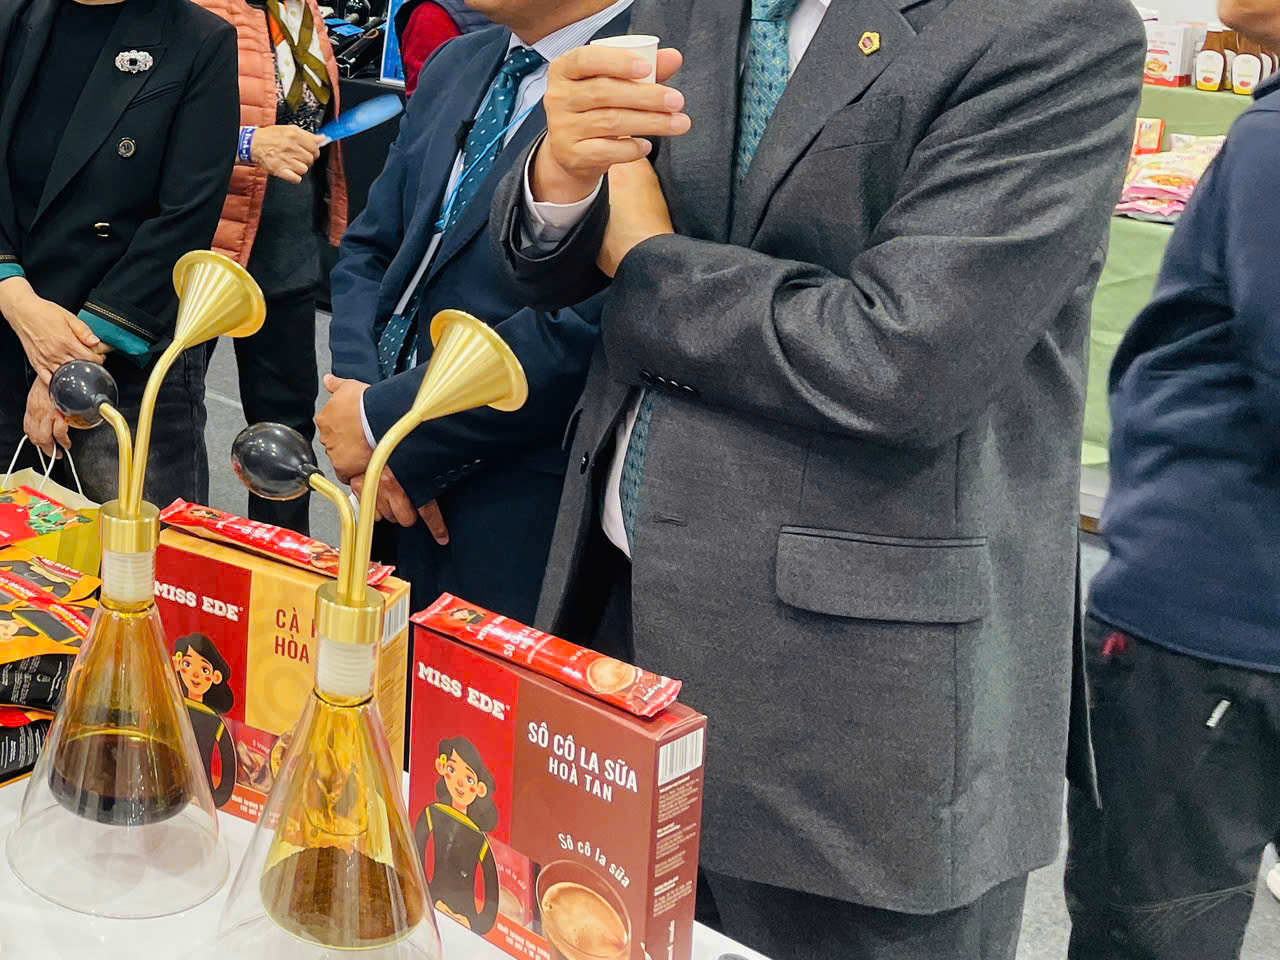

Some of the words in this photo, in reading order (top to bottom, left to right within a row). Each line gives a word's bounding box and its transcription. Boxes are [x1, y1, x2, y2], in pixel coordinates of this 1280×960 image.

[154, 581, 197, 607] MISS
[201, 596, 239, 622] EDE
[276, 607, 299, 633] CÀ
[274, 634, 310, 664] HÒA
[418, 662, 463, 698] MISS
[466, 687, 506, 721] EDE
[528, 722, 549, 748] SÔ
[553, 734, 575, 761] CÔ
[580, 747, 599, 774] LA
[604, 759, 638, 793] SỮA
[549, 756, 578, 786] HOÀ
[584, 774, 612, 802] TAN
[558, 833, 574, 850] Sô
[577, 841, 591, 857] cô
[595, 847, 606, 866] la
[609, 863, 630, 888] sữa
